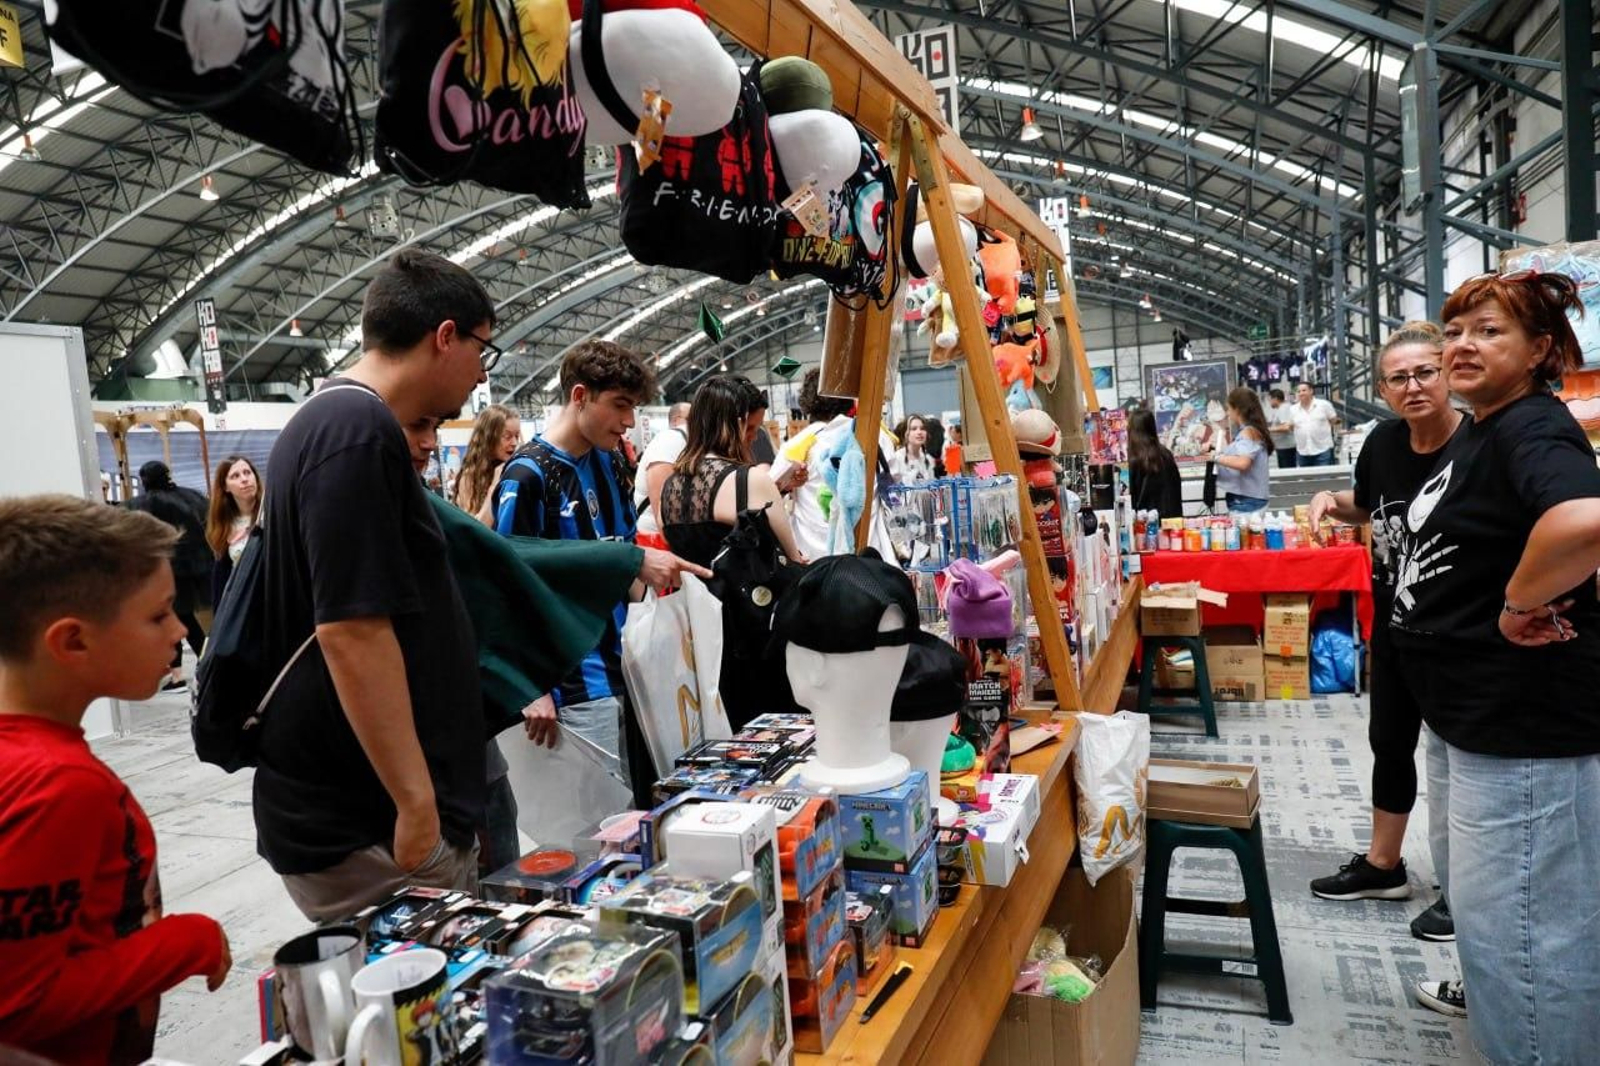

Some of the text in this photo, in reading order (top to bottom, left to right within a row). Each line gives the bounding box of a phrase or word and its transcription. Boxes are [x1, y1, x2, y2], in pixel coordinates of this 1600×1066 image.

[428, 38, 587, 158] Candy
[968, 682, 1001, 690] MATCH
[851, 800, 892, 812] MINECRAFT
